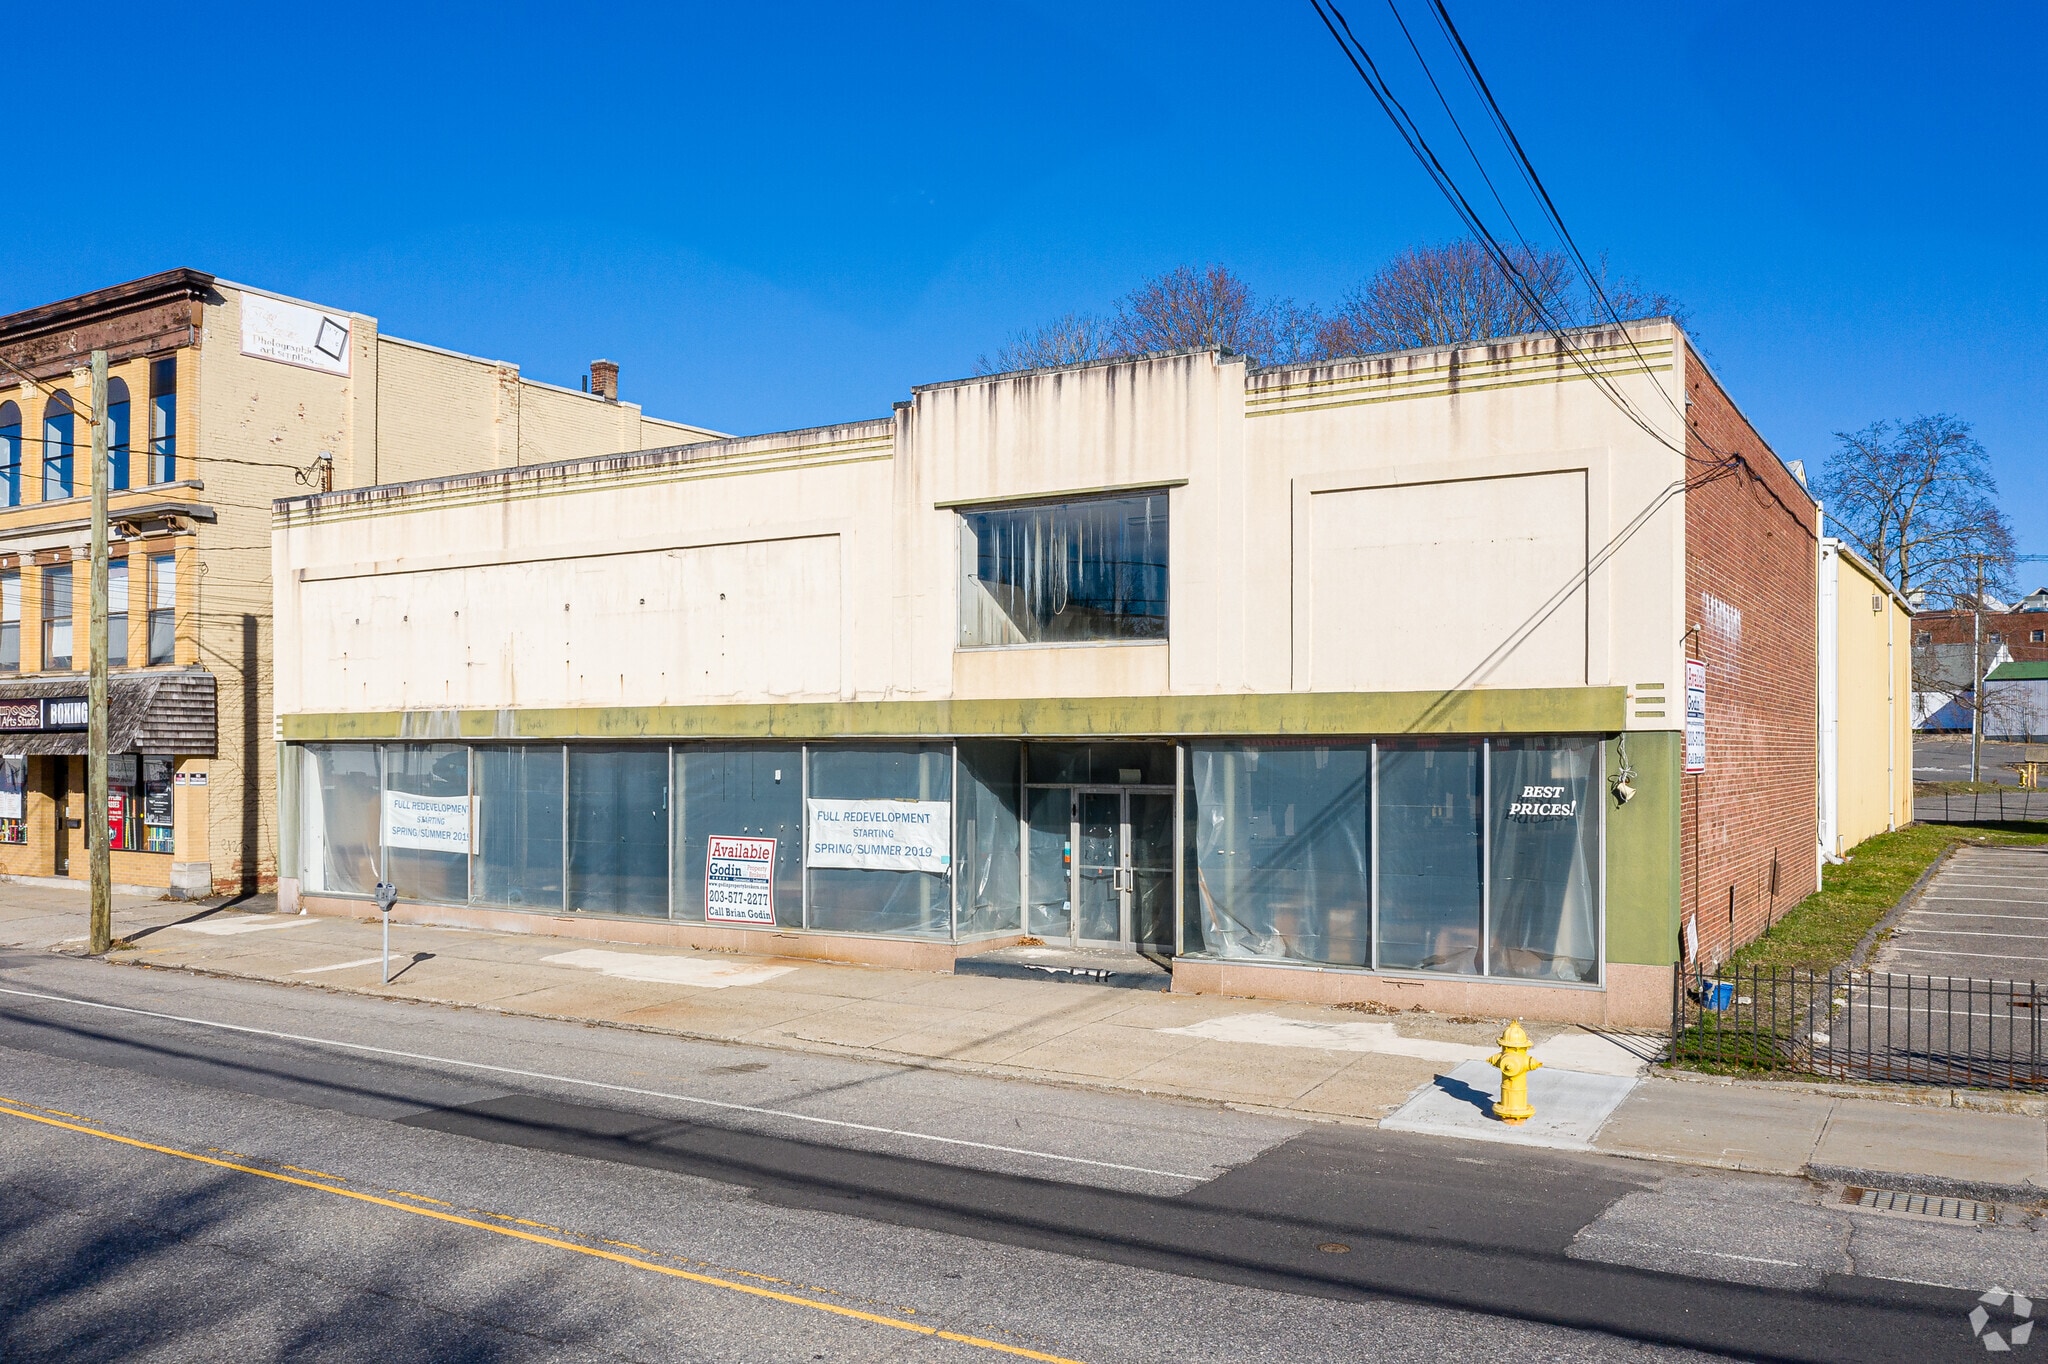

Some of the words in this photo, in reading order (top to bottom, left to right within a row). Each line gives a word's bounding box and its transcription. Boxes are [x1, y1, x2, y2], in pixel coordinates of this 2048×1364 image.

[50, 702, 88, 725] BOXING
[1, 716, 17, 727] Arts
[17, 716, 40, 727] Studio
[1521, 785, 1565, 798] BEST
[394, 800, 410, 810] FULL
[1509, 800, 1576, 816] PRICES!
[416, 815, 446, 826] STARTING
[817, 810, 840, 822] FULL
[843, 811, 931, 824] REDEVELOPMENT
[853, 828, 894, 839] STARTING
[712, 842, 770, 860] Available
[814, 843, 902, 857] SPRING/SUMMER
[904, 846, 933, 858] 2019
[709, 862, 742, 877] Godin
[746, 864, 768, 873] Property
[709, 890, 768, 906] 203-577-2277
[709, 906, 724, 917] Call
[725, 907, 746, 919] Brian
[747, 909, 771, 920] Godin
